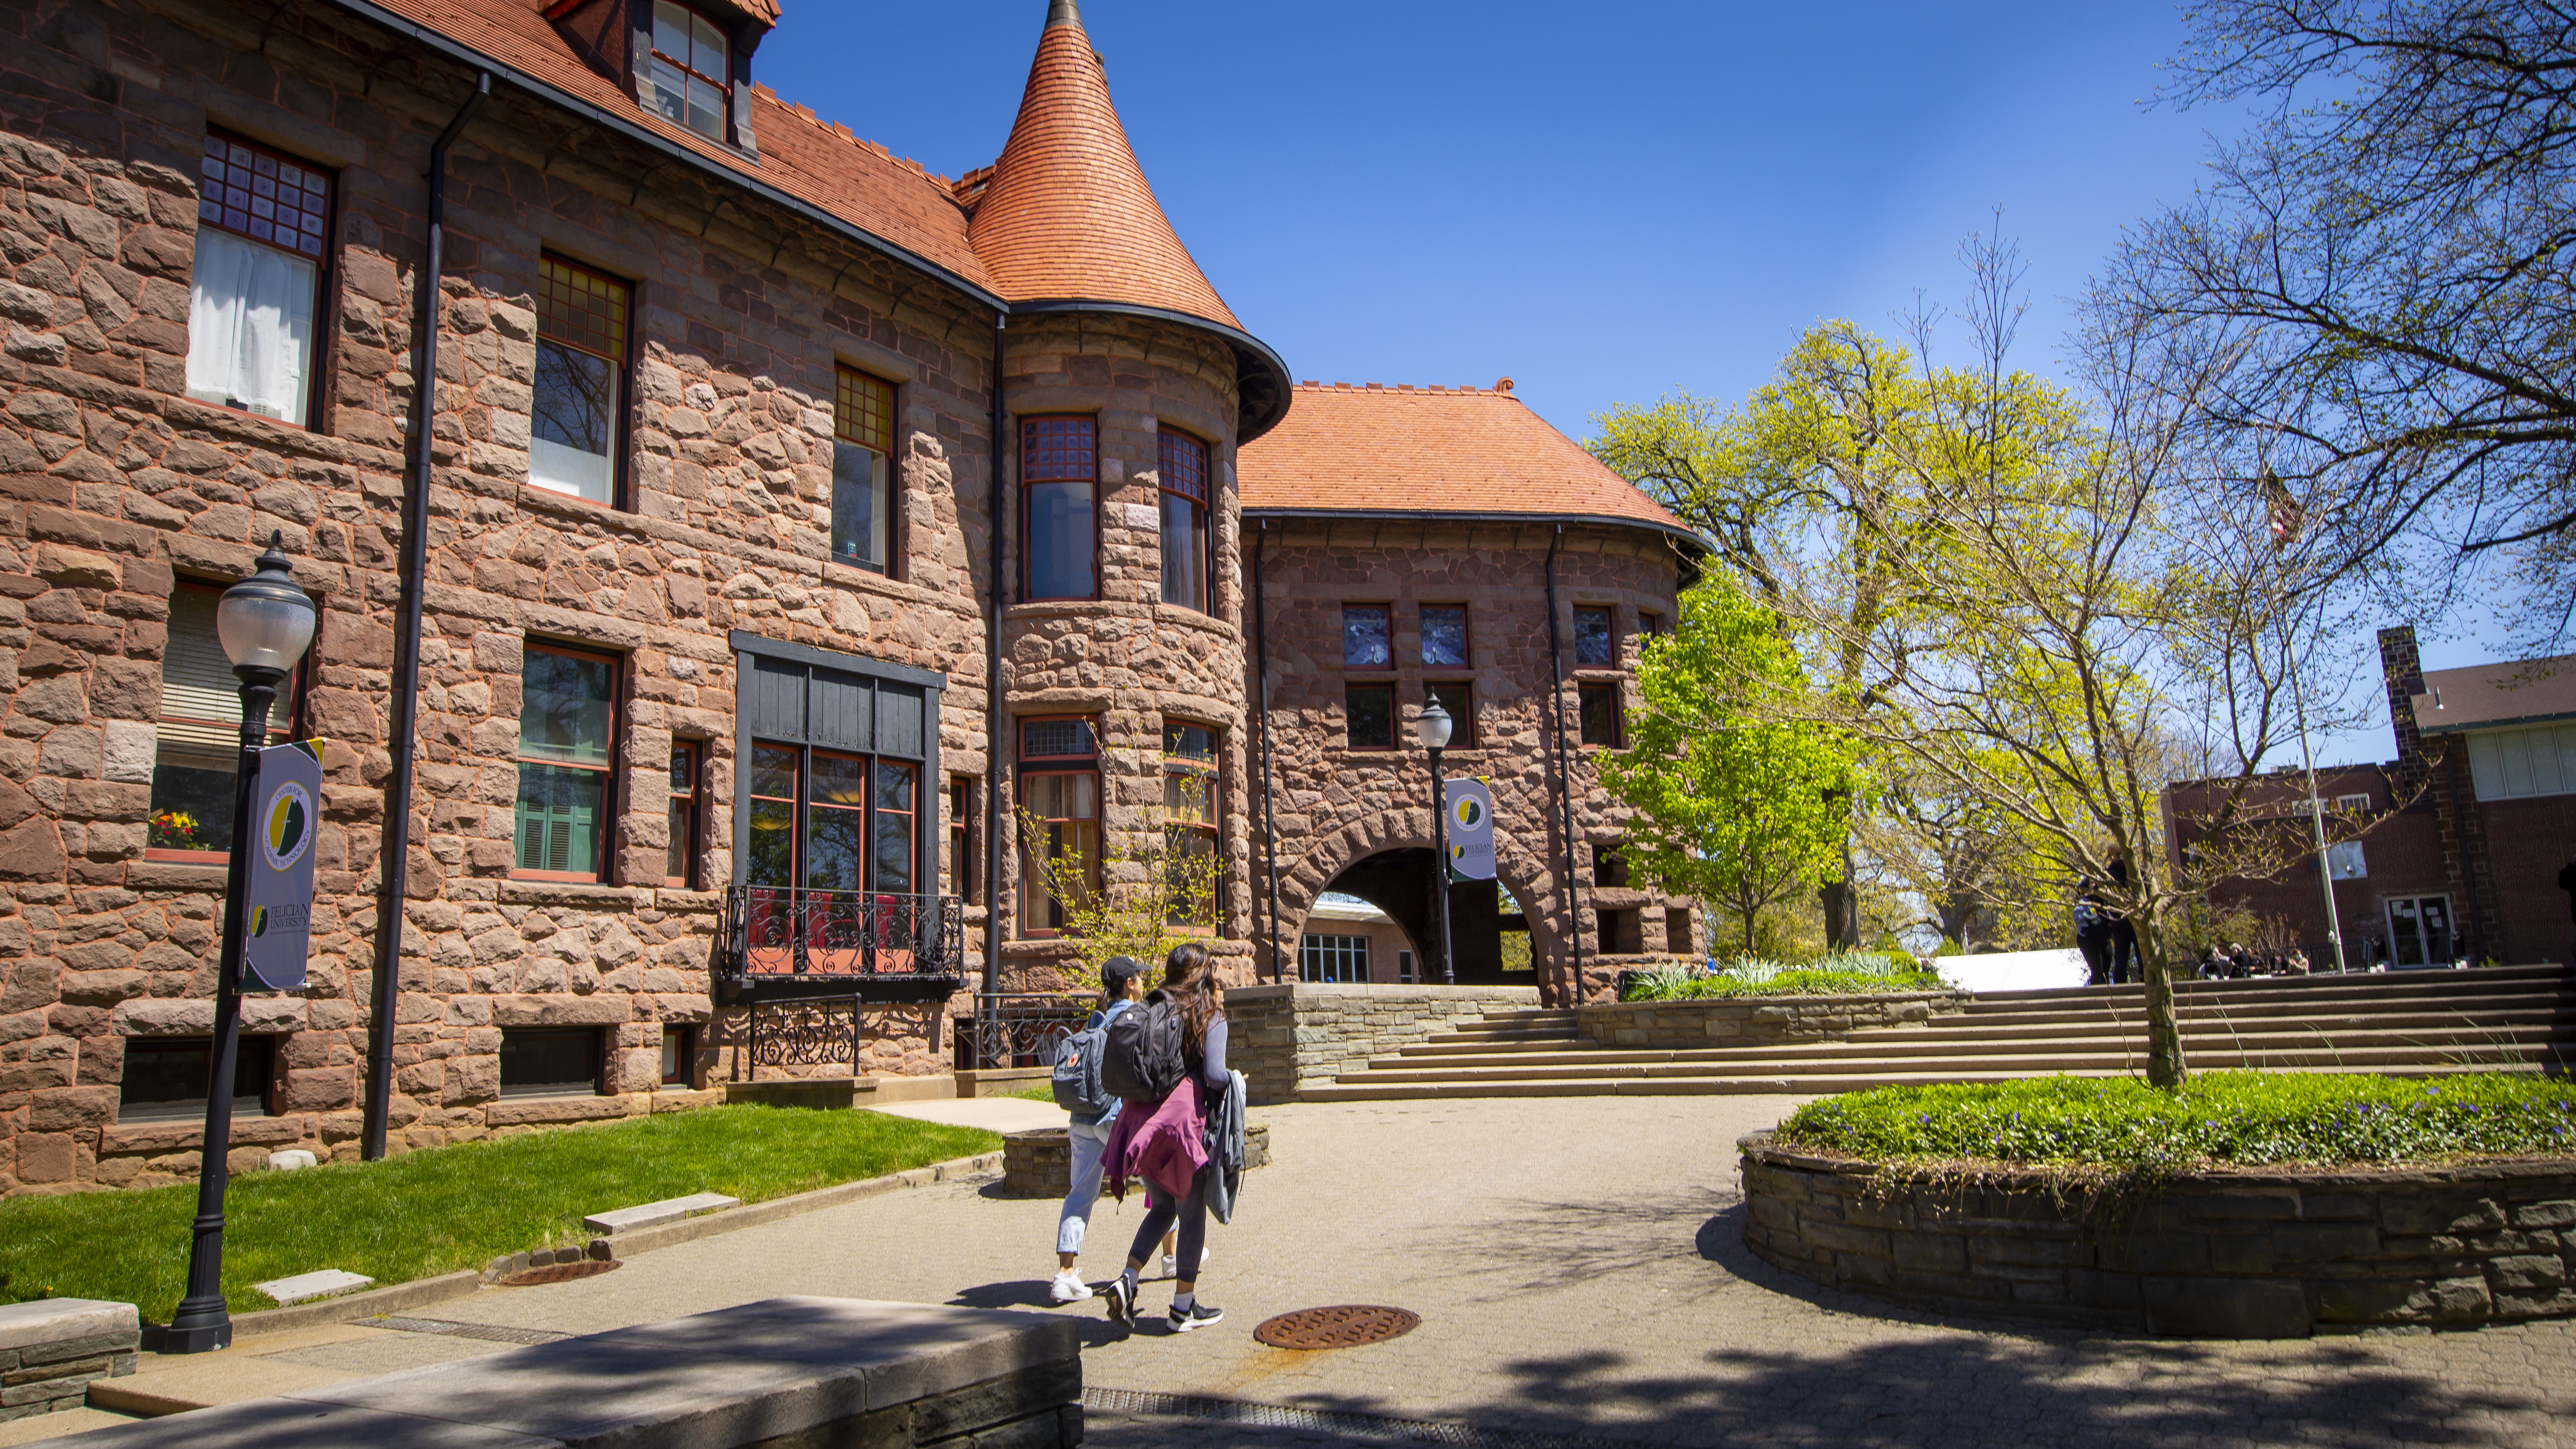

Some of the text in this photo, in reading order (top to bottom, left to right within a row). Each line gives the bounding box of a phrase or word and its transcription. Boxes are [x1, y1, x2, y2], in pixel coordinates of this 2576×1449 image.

[276, 786, 302, 801] CENTER FOR
[280, 829, 310, 867] TECHNOLOGY
[271, 903, 310, 918] FELICIAN
[270, 916, 309, 929] UNIVERSITY
